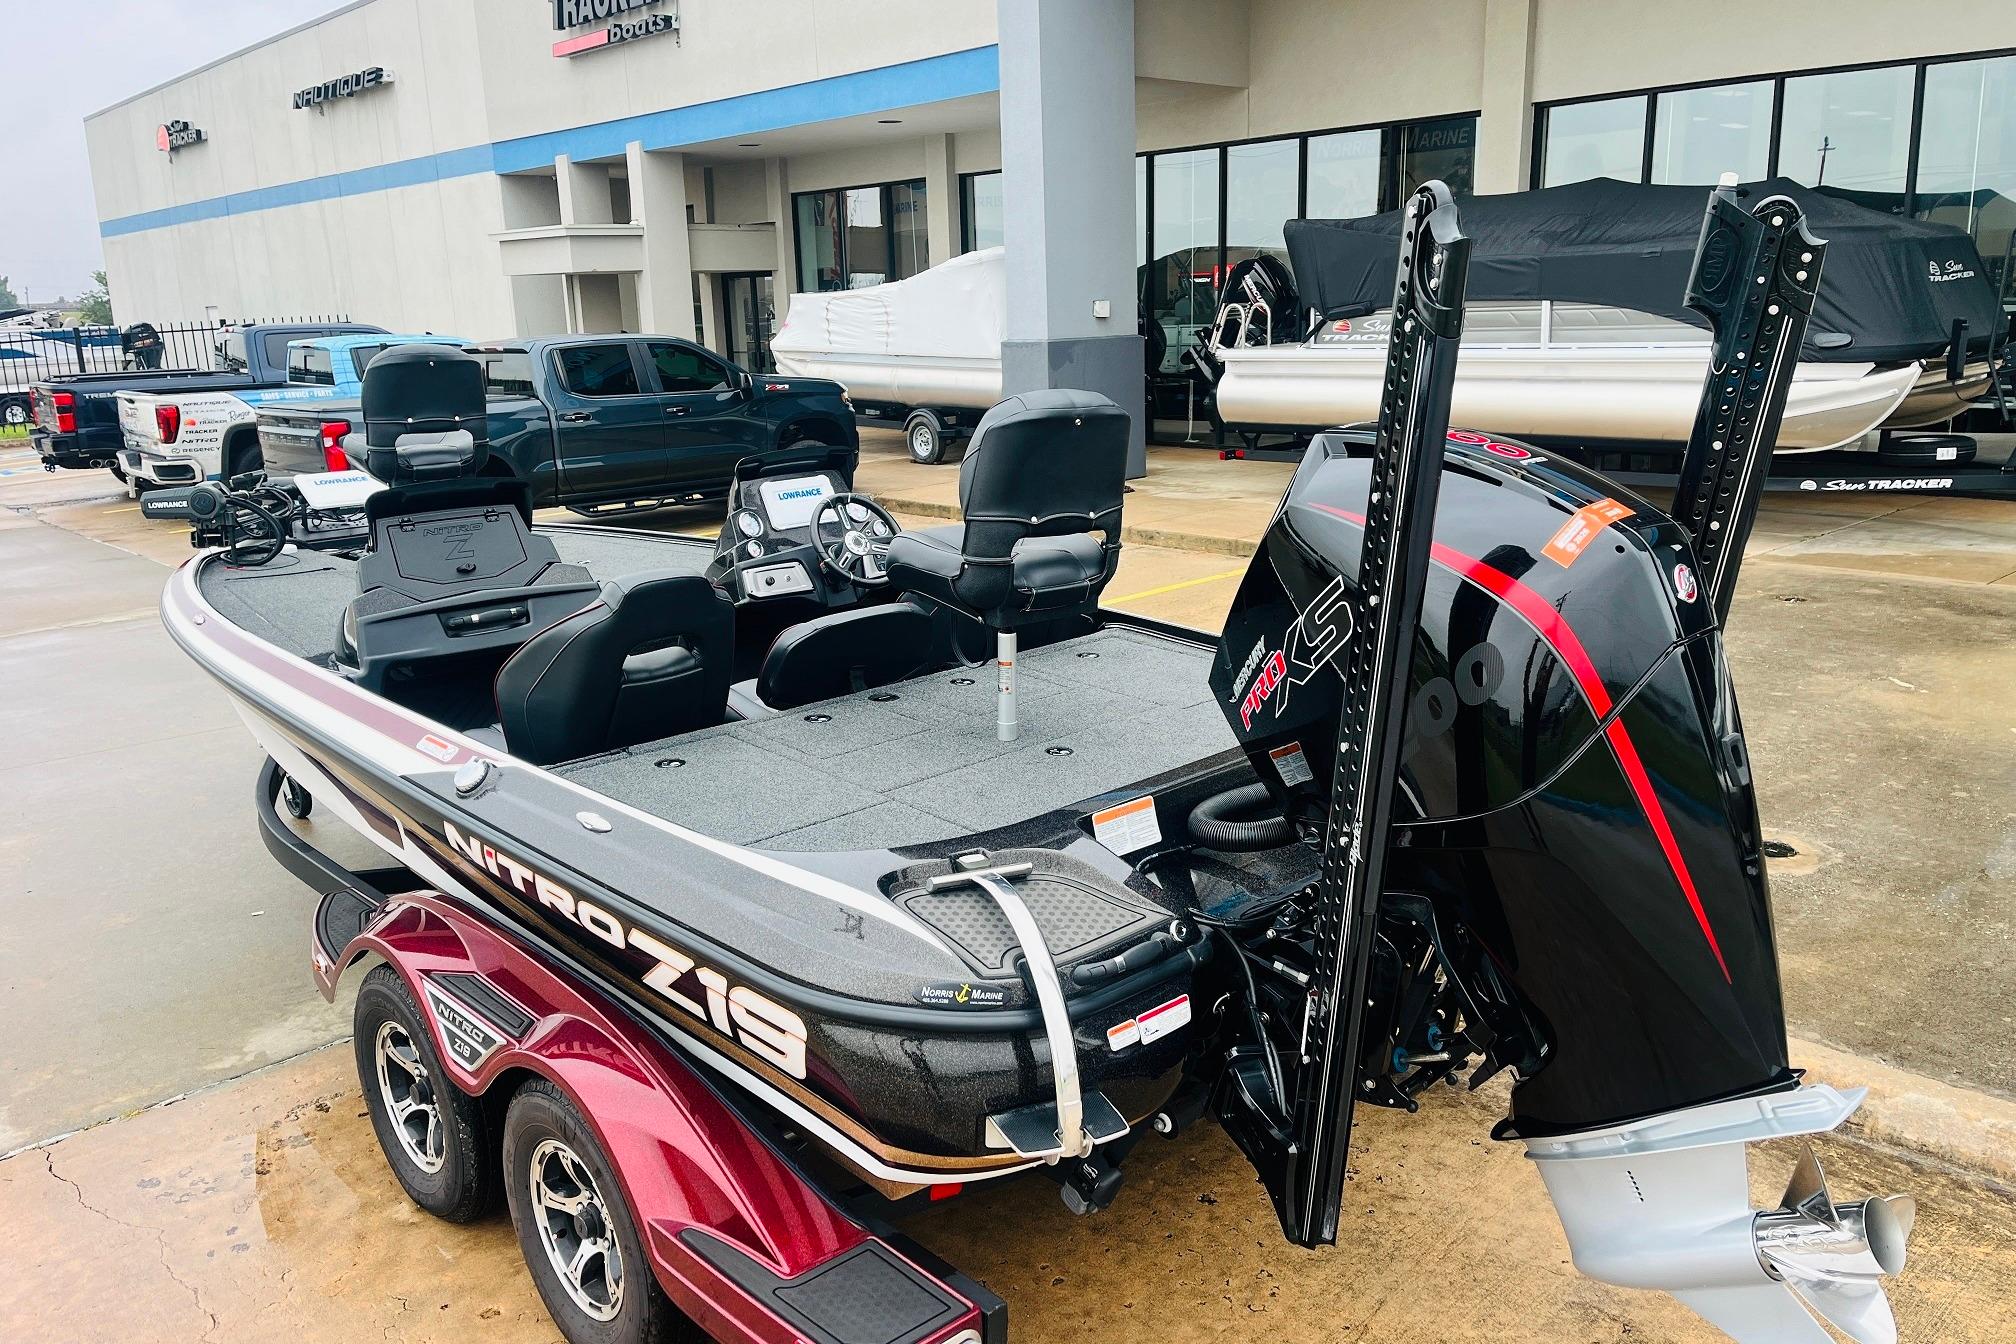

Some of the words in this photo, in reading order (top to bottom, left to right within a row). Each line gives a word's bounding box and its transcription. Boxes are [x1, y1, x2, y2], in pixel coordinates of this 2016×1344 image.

[548, 0, 661, 30] TRAC
[609, 14, 665, 42] boats
[293, 67, 382, 109] NAUTIQUE
[169, 129, 198, 148] TRACKER
[1929, 270, 1975, 282] TRACKER
[1243, 275, 1268, 304] MERCU
[1358, 320, 1392, 333] Su
[1322, 334, 1390, 342] TRACK
[83, 392, 115, 400] TREM
[313, 475, 369, 486] LOWRANCE
[1821, 479, 1867, 491] Sun
[1867, 478, 1953, 490] TRACKER
[777, 487, 823, 501] LOWRANCE
[147, 500, 188, 509] LOWRANCE
[1232, 634, 1266, 700] MERCURY
[1240, 649, 1287, 732] PRO
[921, 986, 954, 999] NORRIS
[971, 989, 1004, 1000] MARINE
[627, 926, 808, 1080] Z19
[438, 1003, 485, 1043] NITRO
[453, 1038, 471, 1058] Z19
